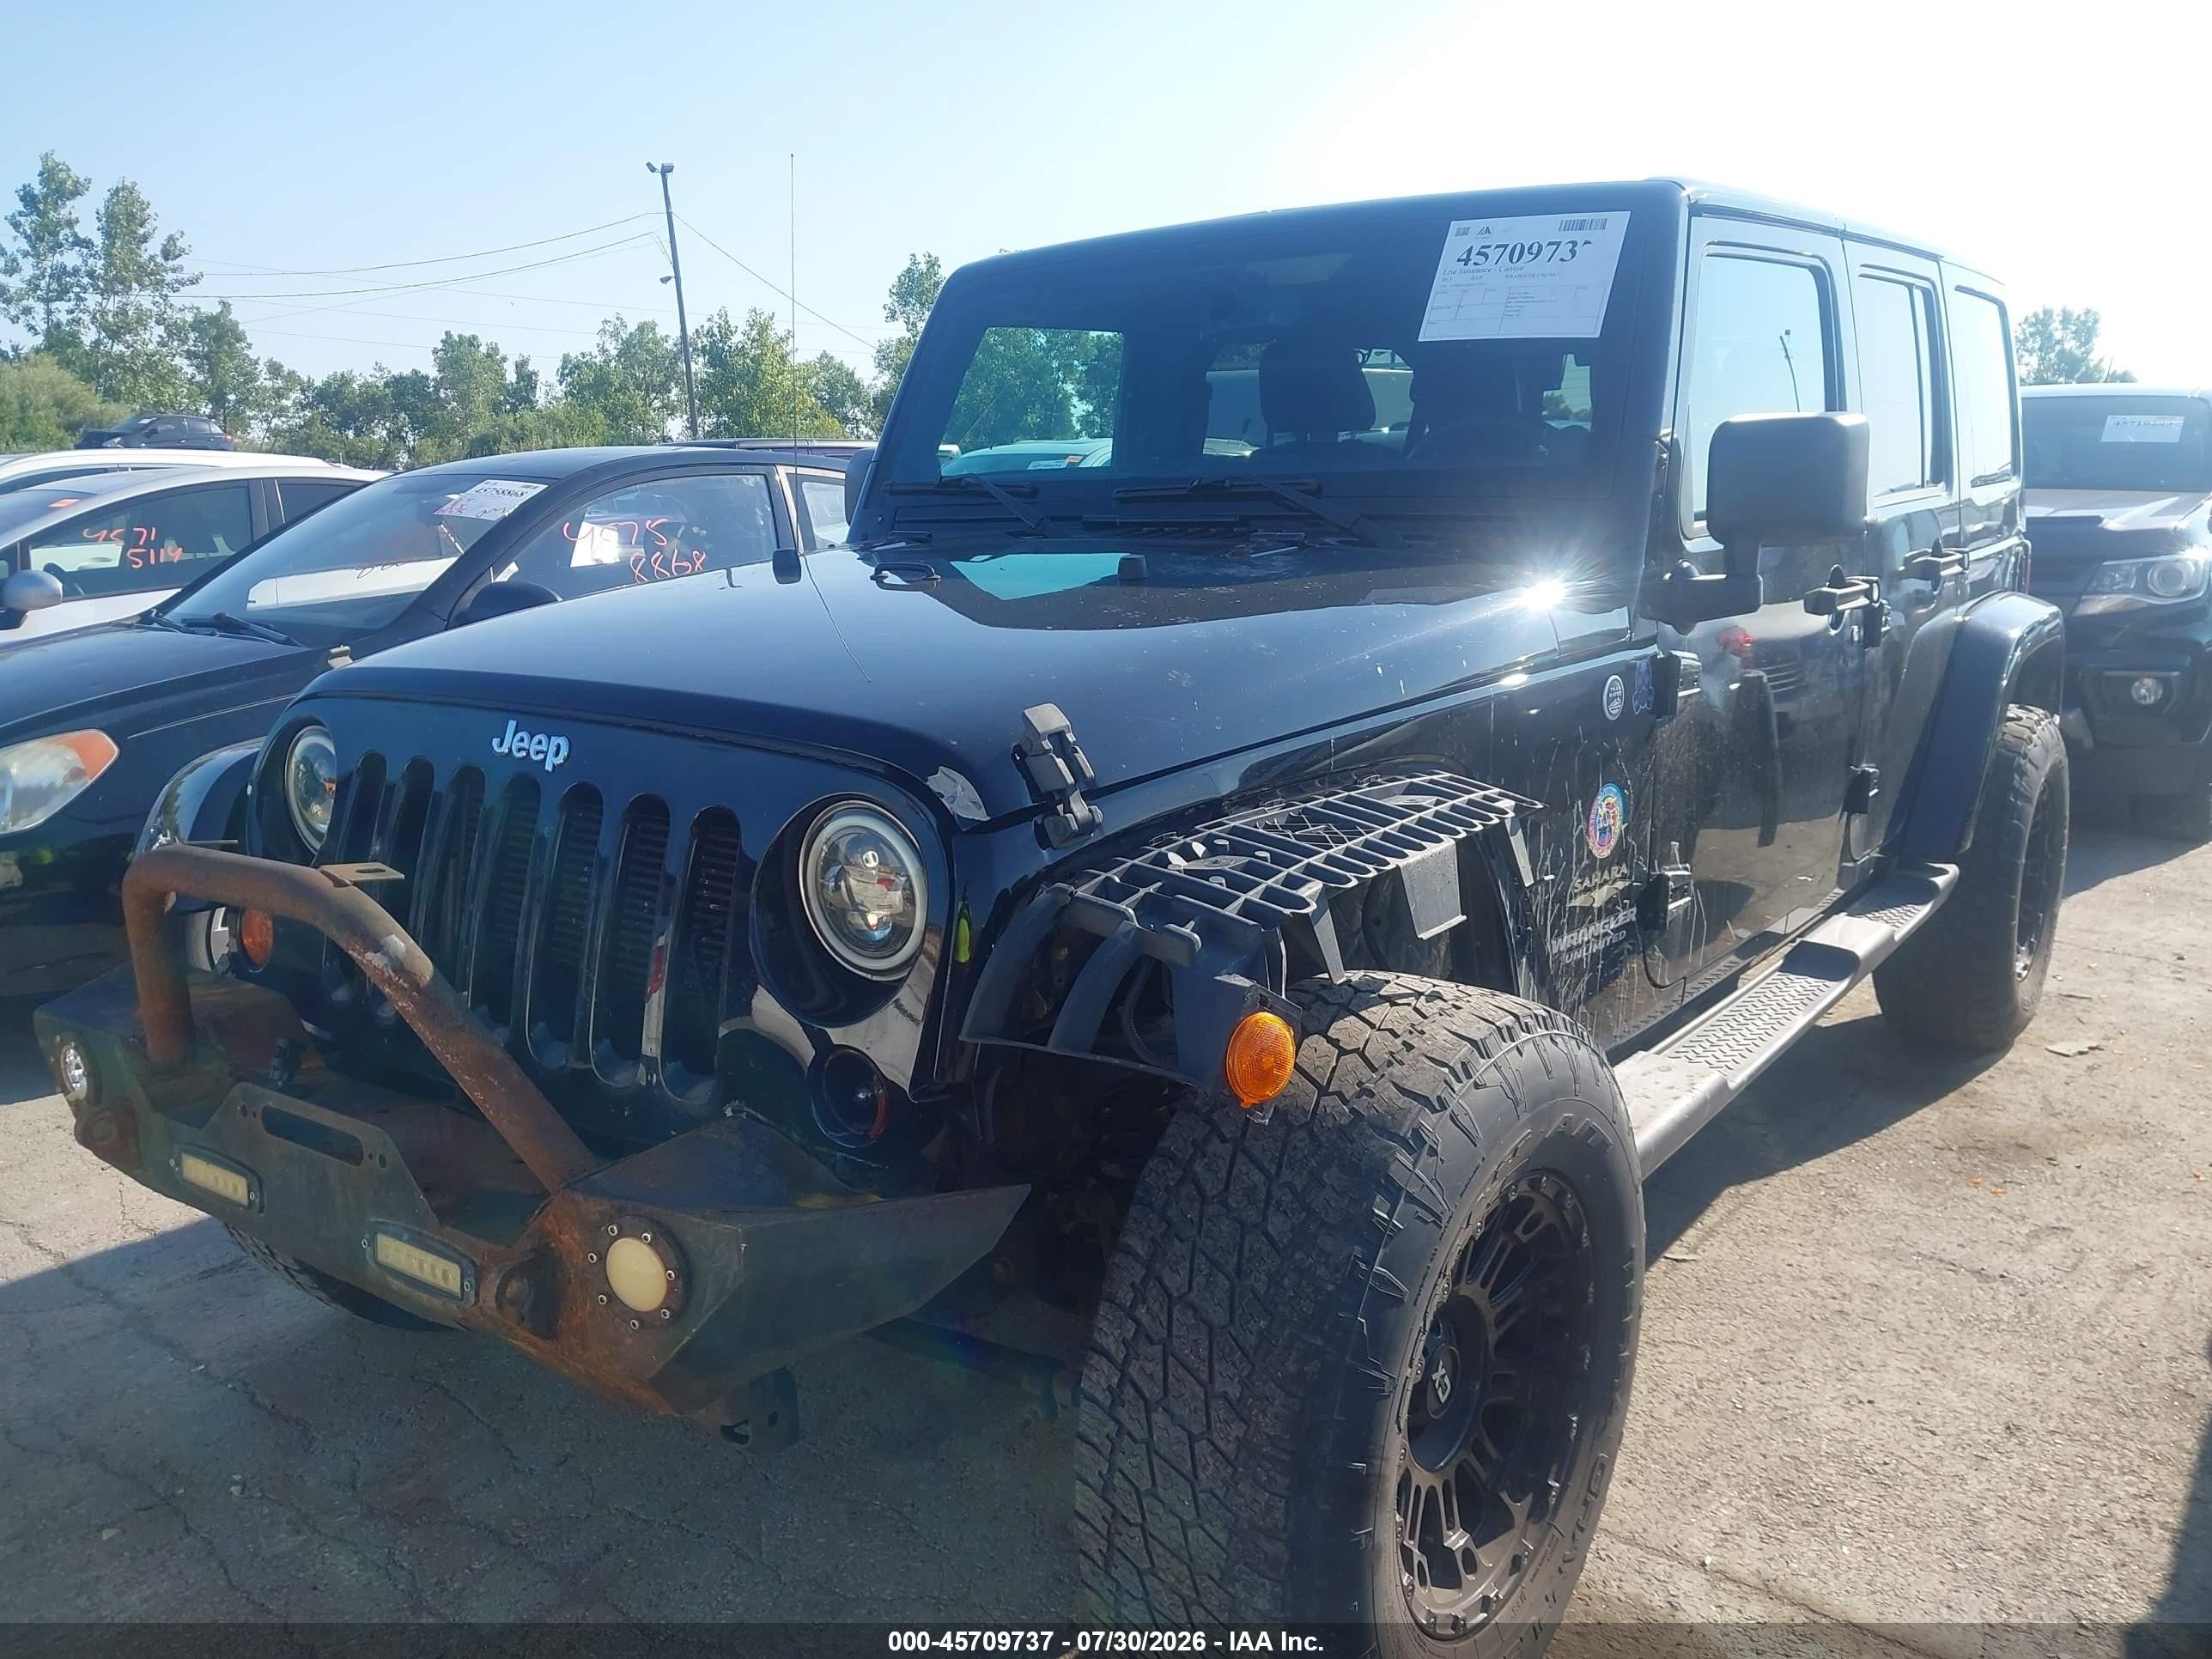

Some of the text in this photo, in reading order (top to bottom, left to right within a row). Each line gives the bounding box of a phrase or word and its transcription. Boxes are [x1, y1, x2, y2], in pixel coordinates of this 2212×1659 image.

[630, 548, 707, 584] 8868
[492, 720, 569, 773] Jeep
[1574, 863, 1628, 893] SAHARA
[1551, 907, 1637, 954] WRANGLER
[1565, 930, 1627, 963] UNLIMITED
